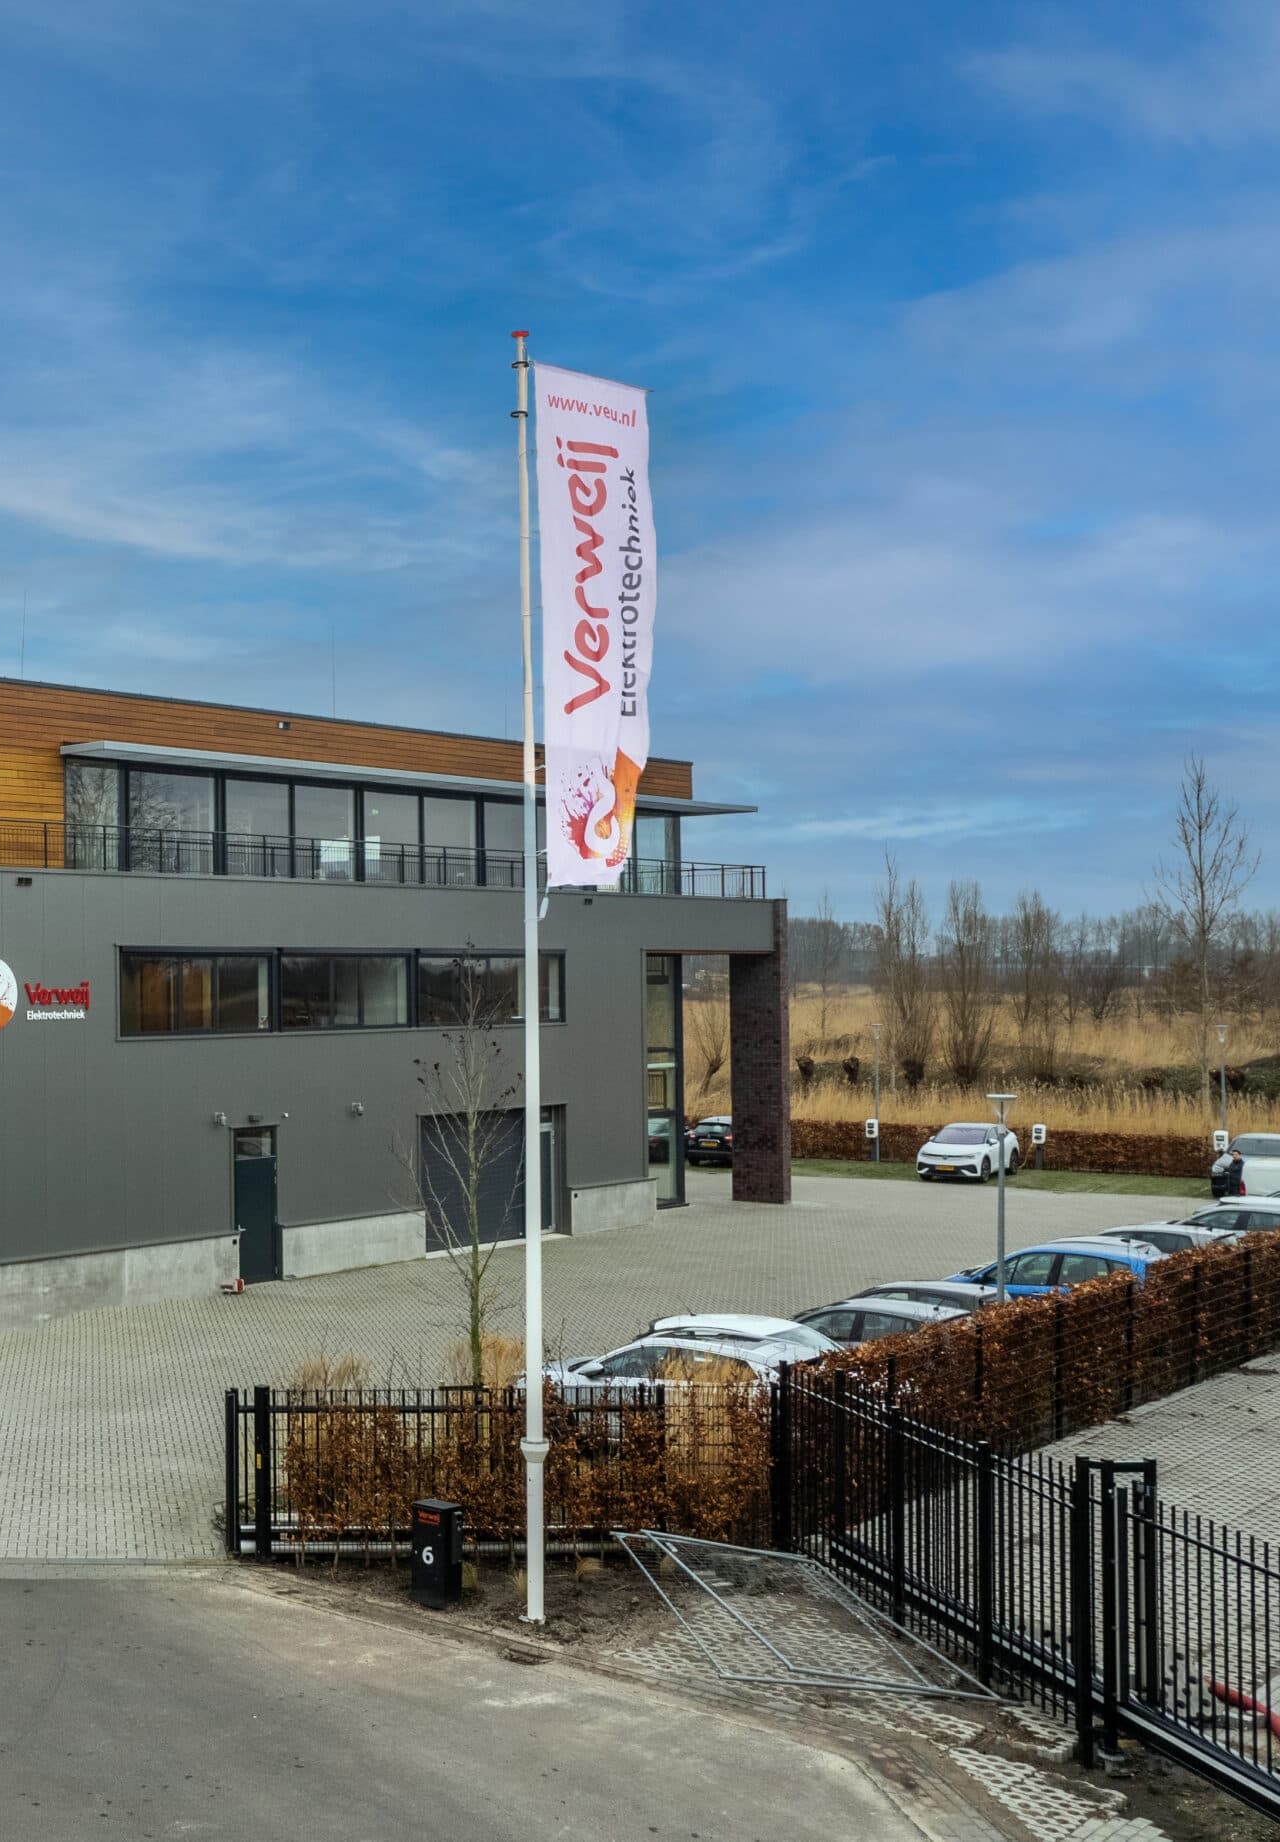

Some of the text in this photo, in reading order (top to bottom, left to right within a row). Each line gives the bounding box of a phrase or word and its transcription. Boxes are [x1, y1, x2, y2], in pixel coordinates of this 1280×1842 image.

[547, 394, 636, 427] www.veu.nl
[556, 435, 619, 714] Verweij
[618, 466, 643, 717] Elektrotechniek
[24, 981, 89, 1010] Verweij
[26, 1009, 85, 1021] Elektrotechniek
[422, 1546, 434, 1565] 6
